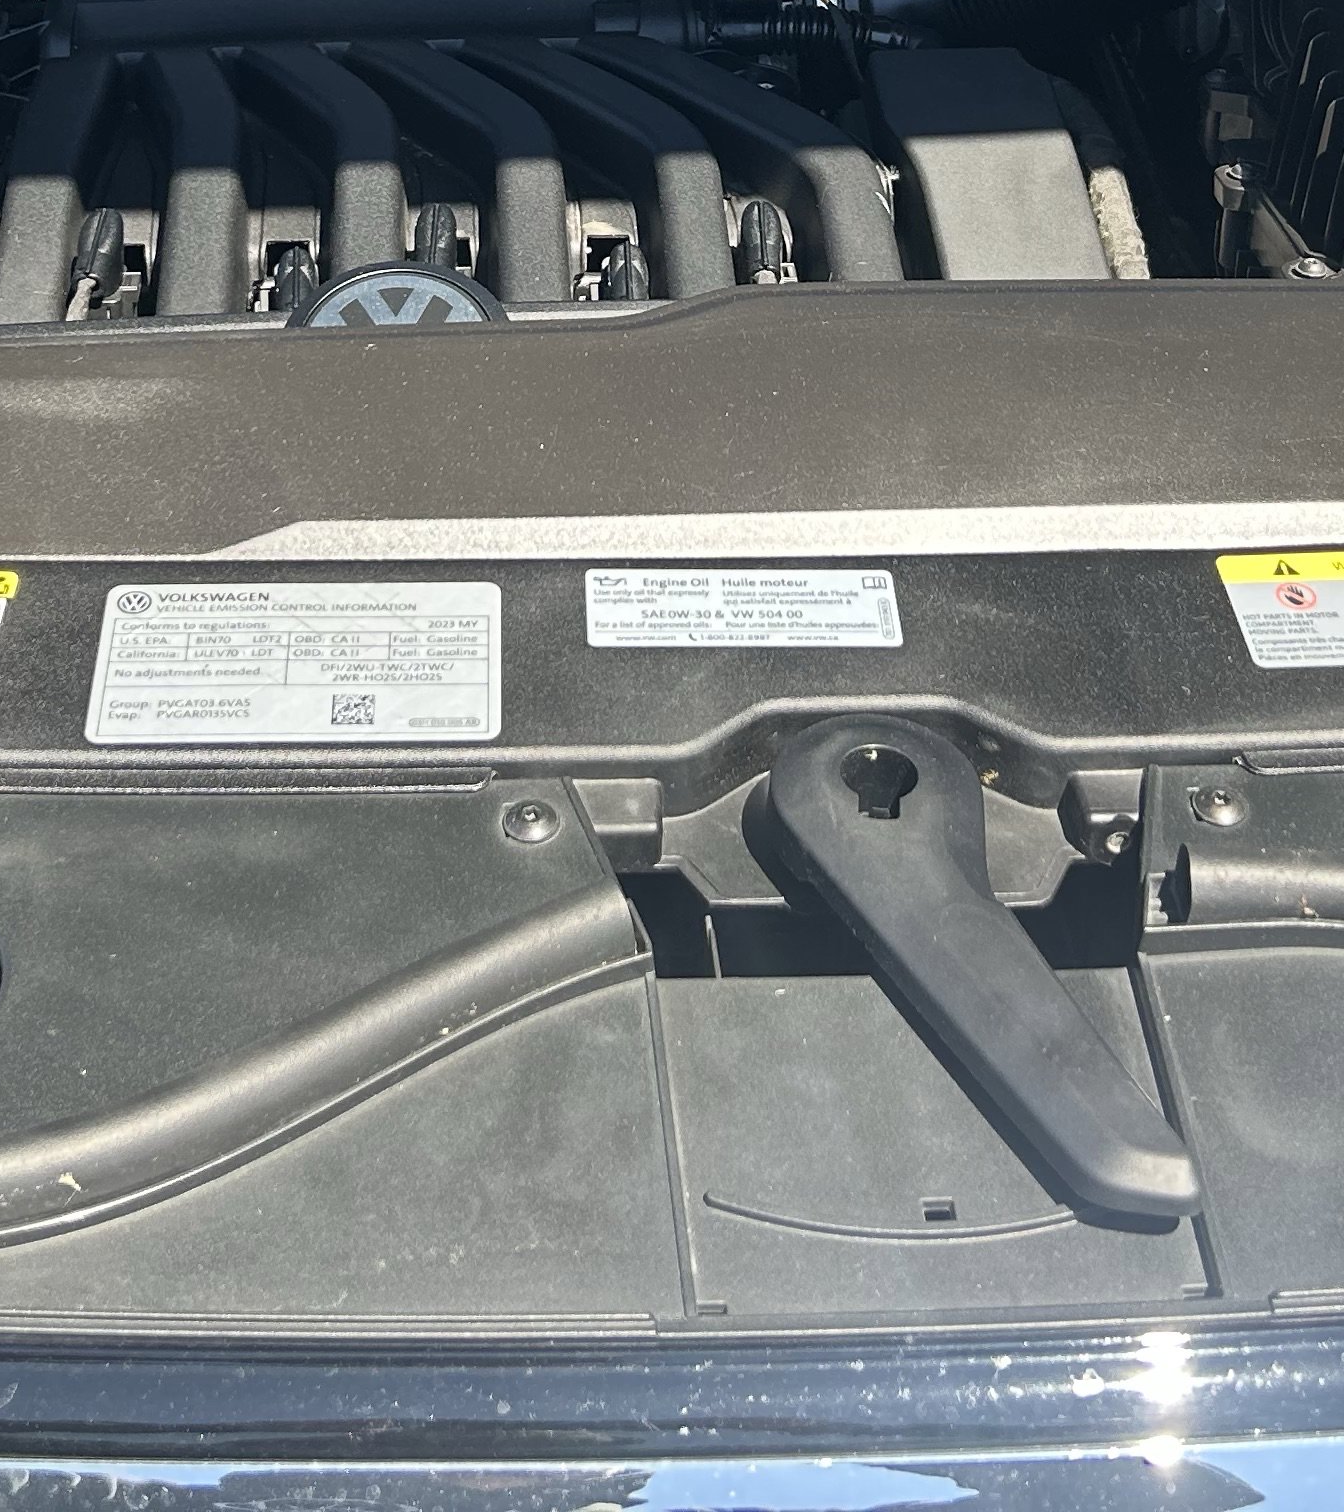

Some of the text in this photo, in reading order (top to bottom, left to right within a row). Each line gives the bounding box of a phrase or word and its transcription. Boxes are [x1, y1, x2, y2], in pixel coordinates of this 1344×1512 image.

[643, 577, 709, 588] Engine Oil
[721, 577, 808, 587] Huile moteur
[157, 592, 270, 602] VOLKSWAGEN
[613, 589, 632, 597] only
[668, 589, 709, 598] expressly
[759, 590, 815, 598] uniquement
[723, 598, 738, 606] qui
[156, 602, 417, 613] VEHICLE EMISSION CONTROL INFORMATION
[714, 610, 725, 619] &
[731, 609, 754, 619] VW
[758, 609, 782, 619] 504
[786, 609, 803, 619] 00
[121, 619, 479, 632] Conforms to regulations: 2023 MY
[620, 620, 633, 628] list
[635, 620, 646, 628] of
[648, 620, 691, 629] approved
[1245, 619, 1314, 628] COMPARTMENT
[196, 635, 232, 644] BIN70
[252, 634, 282, 644] LDT2
[331, 635, 348, 644] CA
[427, 634, 478, 643] Gasoline
[194, 648, 239, 658] ULEV70
[251, 648, 274, 657] LDT
[330, 648, 347, 657] CA
[427, 647, 478, 656] Gasoline
[115, 668, 132, 677] No
[135, 667, 212, 679] adjustments
[109, 699, 151, 710] Group:
[108, 710, 141, 721] Evap:
